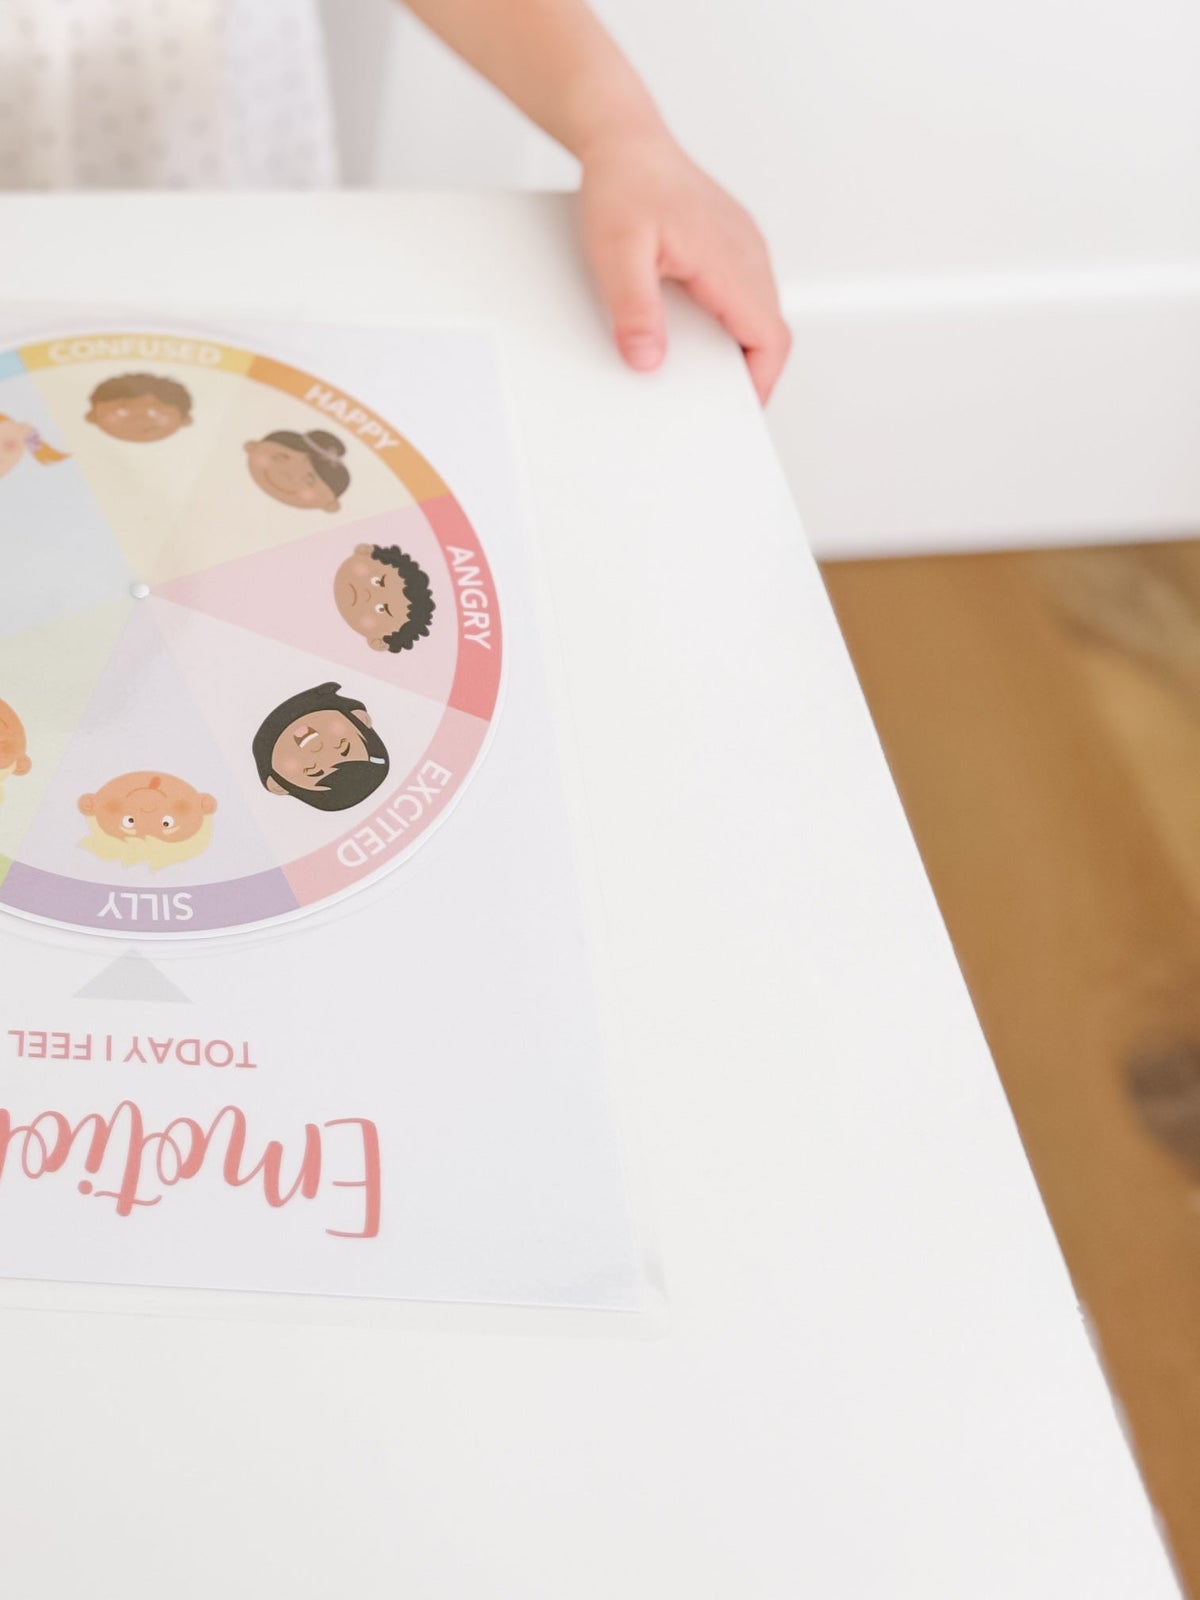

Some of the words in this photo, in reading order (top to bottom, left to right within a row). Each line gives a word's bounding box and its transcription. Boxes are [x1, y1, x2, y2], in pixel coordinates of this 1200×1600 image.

[49, 341, 220, 364] CONFUSED
[305, 383, 399, 453] HAPPY
[447, 545, 492, 650] ANGRY
[336, 758, 453, 868] EXCITED
[97, 891, 194, 921] SILLY
[7, 1029, 92, 1061] FEEL
[105, 1034, 113, 1062] I
[123, 1037, 258, 1069] TODAY
